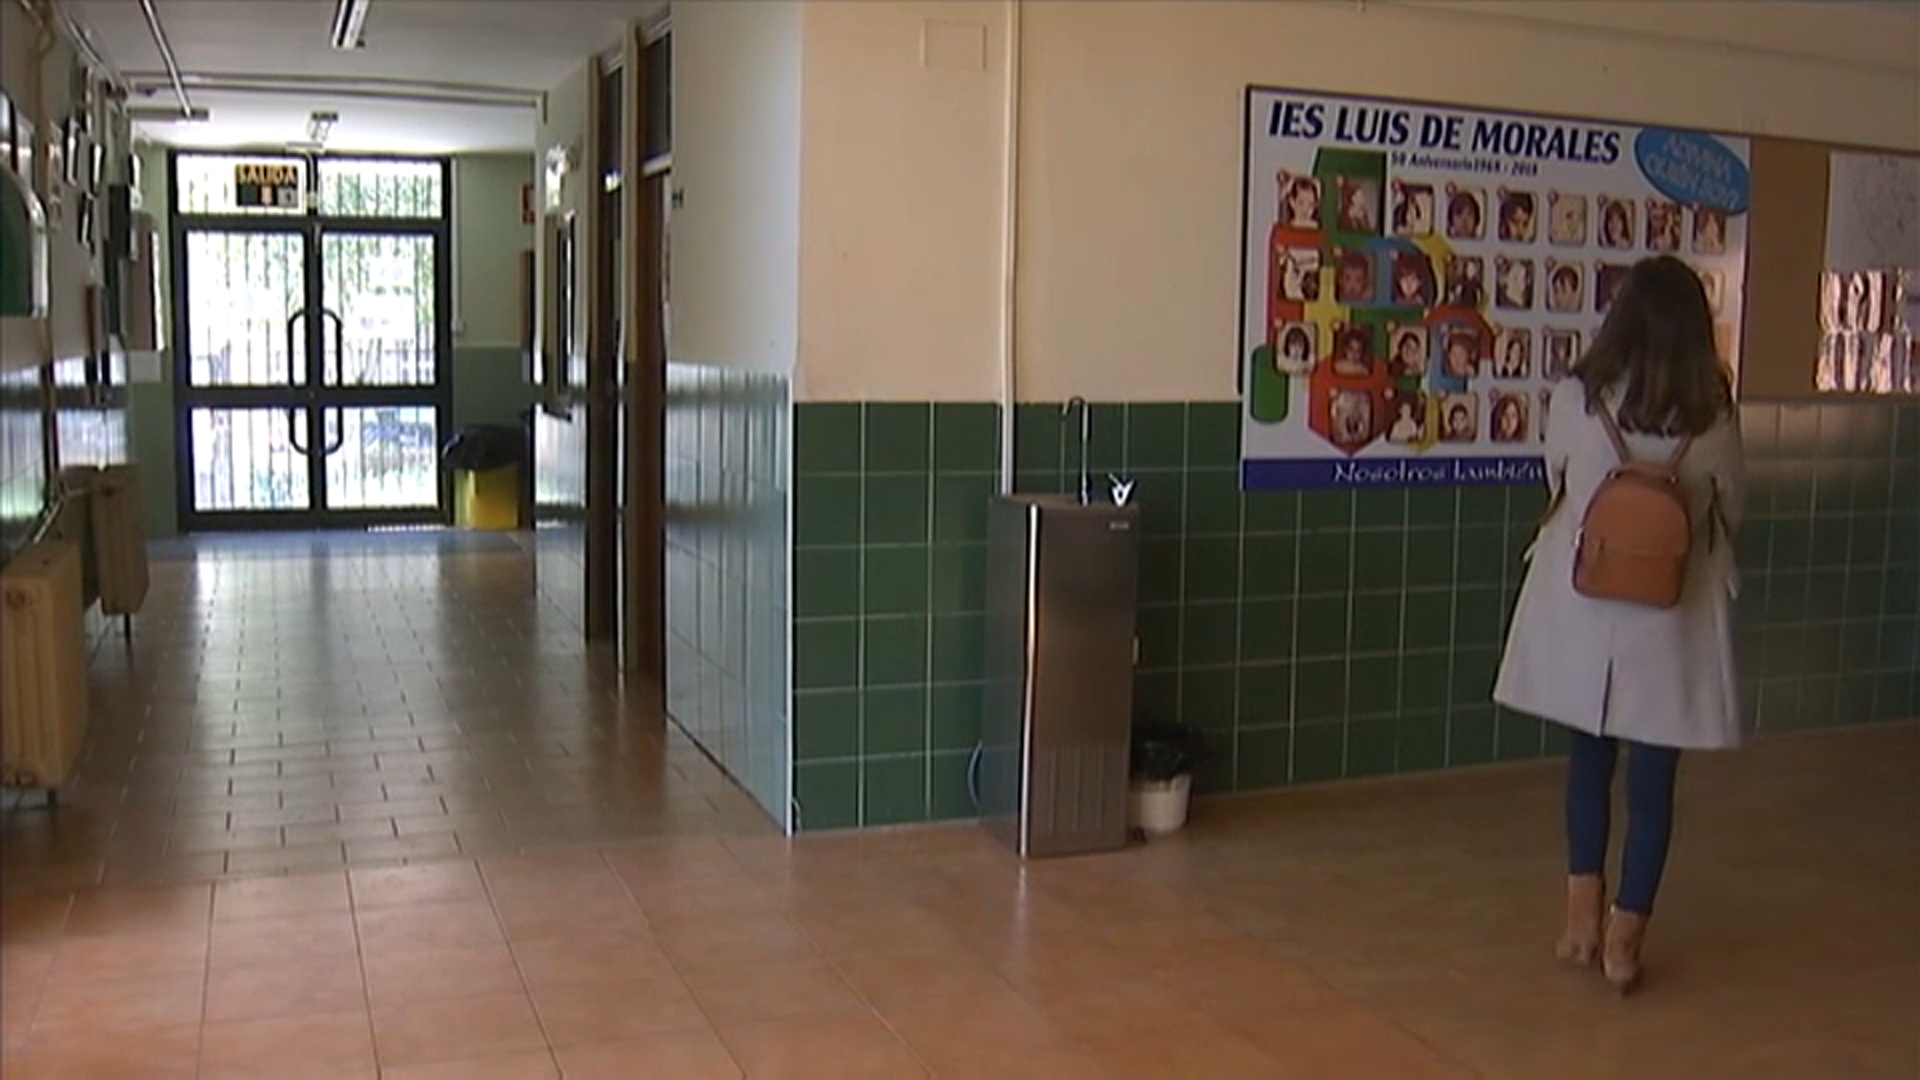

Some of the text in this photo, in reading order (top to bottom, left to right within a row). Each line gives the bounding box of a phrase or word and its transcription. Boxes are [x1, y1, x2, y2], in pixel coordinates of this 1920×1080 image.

[1269, 101, 1620, 164] IES LUIS DE MORALES
[236, 164, 298, 185] SALIDA
[1335, 459, 1446, 481] Nosotros
